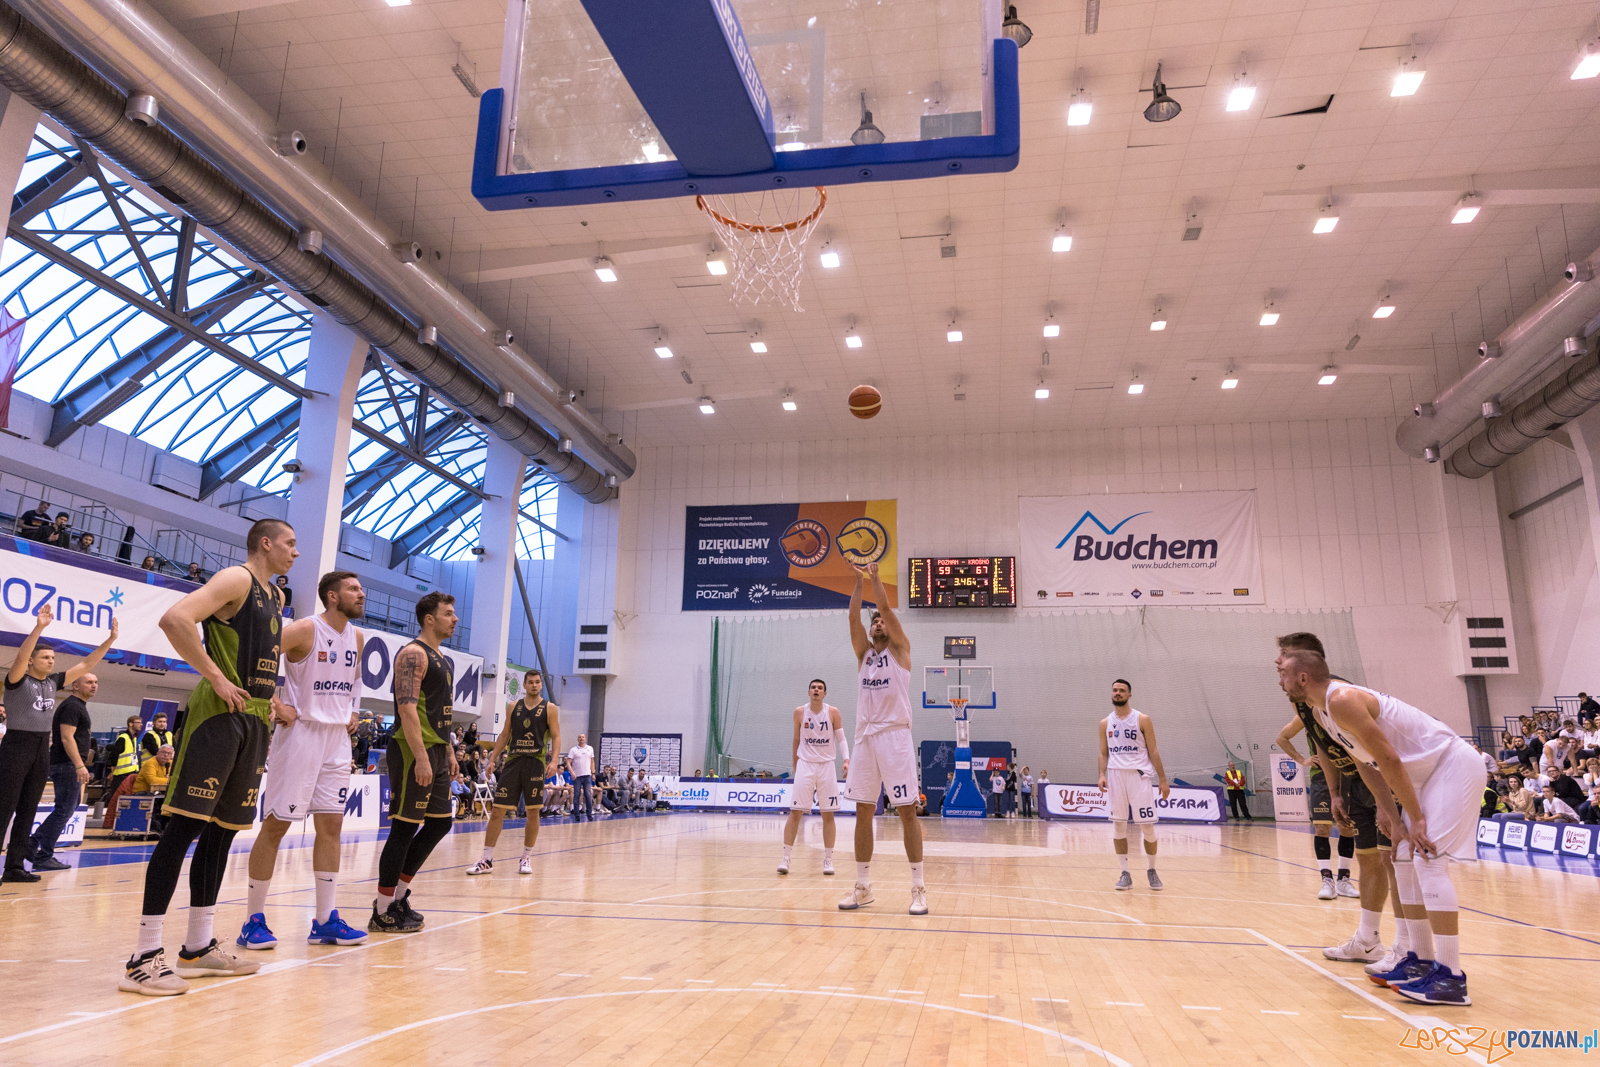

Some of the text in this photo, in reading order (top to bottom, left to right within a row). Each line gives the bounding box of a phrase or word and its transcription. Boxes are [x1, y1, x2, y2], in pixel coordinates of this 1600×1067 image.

[737, 35, 767, 113] SYSTEM
[795, 522, 822, 533] TRENER
[851, 520, 878, 531] TRENER
[699, 538, 770, 554] DZIĘKUJEMY
[1073, 533, 1218, 561] Budchem
[792, 544, 827, 565] SENIORALNY
[708, 556, 744, 564] Państwa
[745, 555, 770, 566] głosy.
[1132, 560, 1218, 570] www.budchem.com.pl
[938, 566, 951, 574] 59
[976, 566, 988, 574] 67
[772, 589, 802, 598] Fundacja
[345, 650, 357, 668] 97
[877, 655, 888, 668] 31
[536, 708, 542, 717] 9
[820, 721, 828, 731] 71
[1124, 729, 1137, 740] 66
[188, 787, 216, 798] ORLEN
[532, 788, 538, 798] 9
[893, 784, 907, 798] 31
[1276, 787, 1304, 796] STREFA VIP
[240, 788, 258, 806] 33
[828, 796, 838, 806] 71
[1058, 790, 1075, 805] U
[1076, 797, 1107, 806] Danuty
[1154, 798, 1209, 809] IOFARM
[1139, 807, 1154, 818] 66
